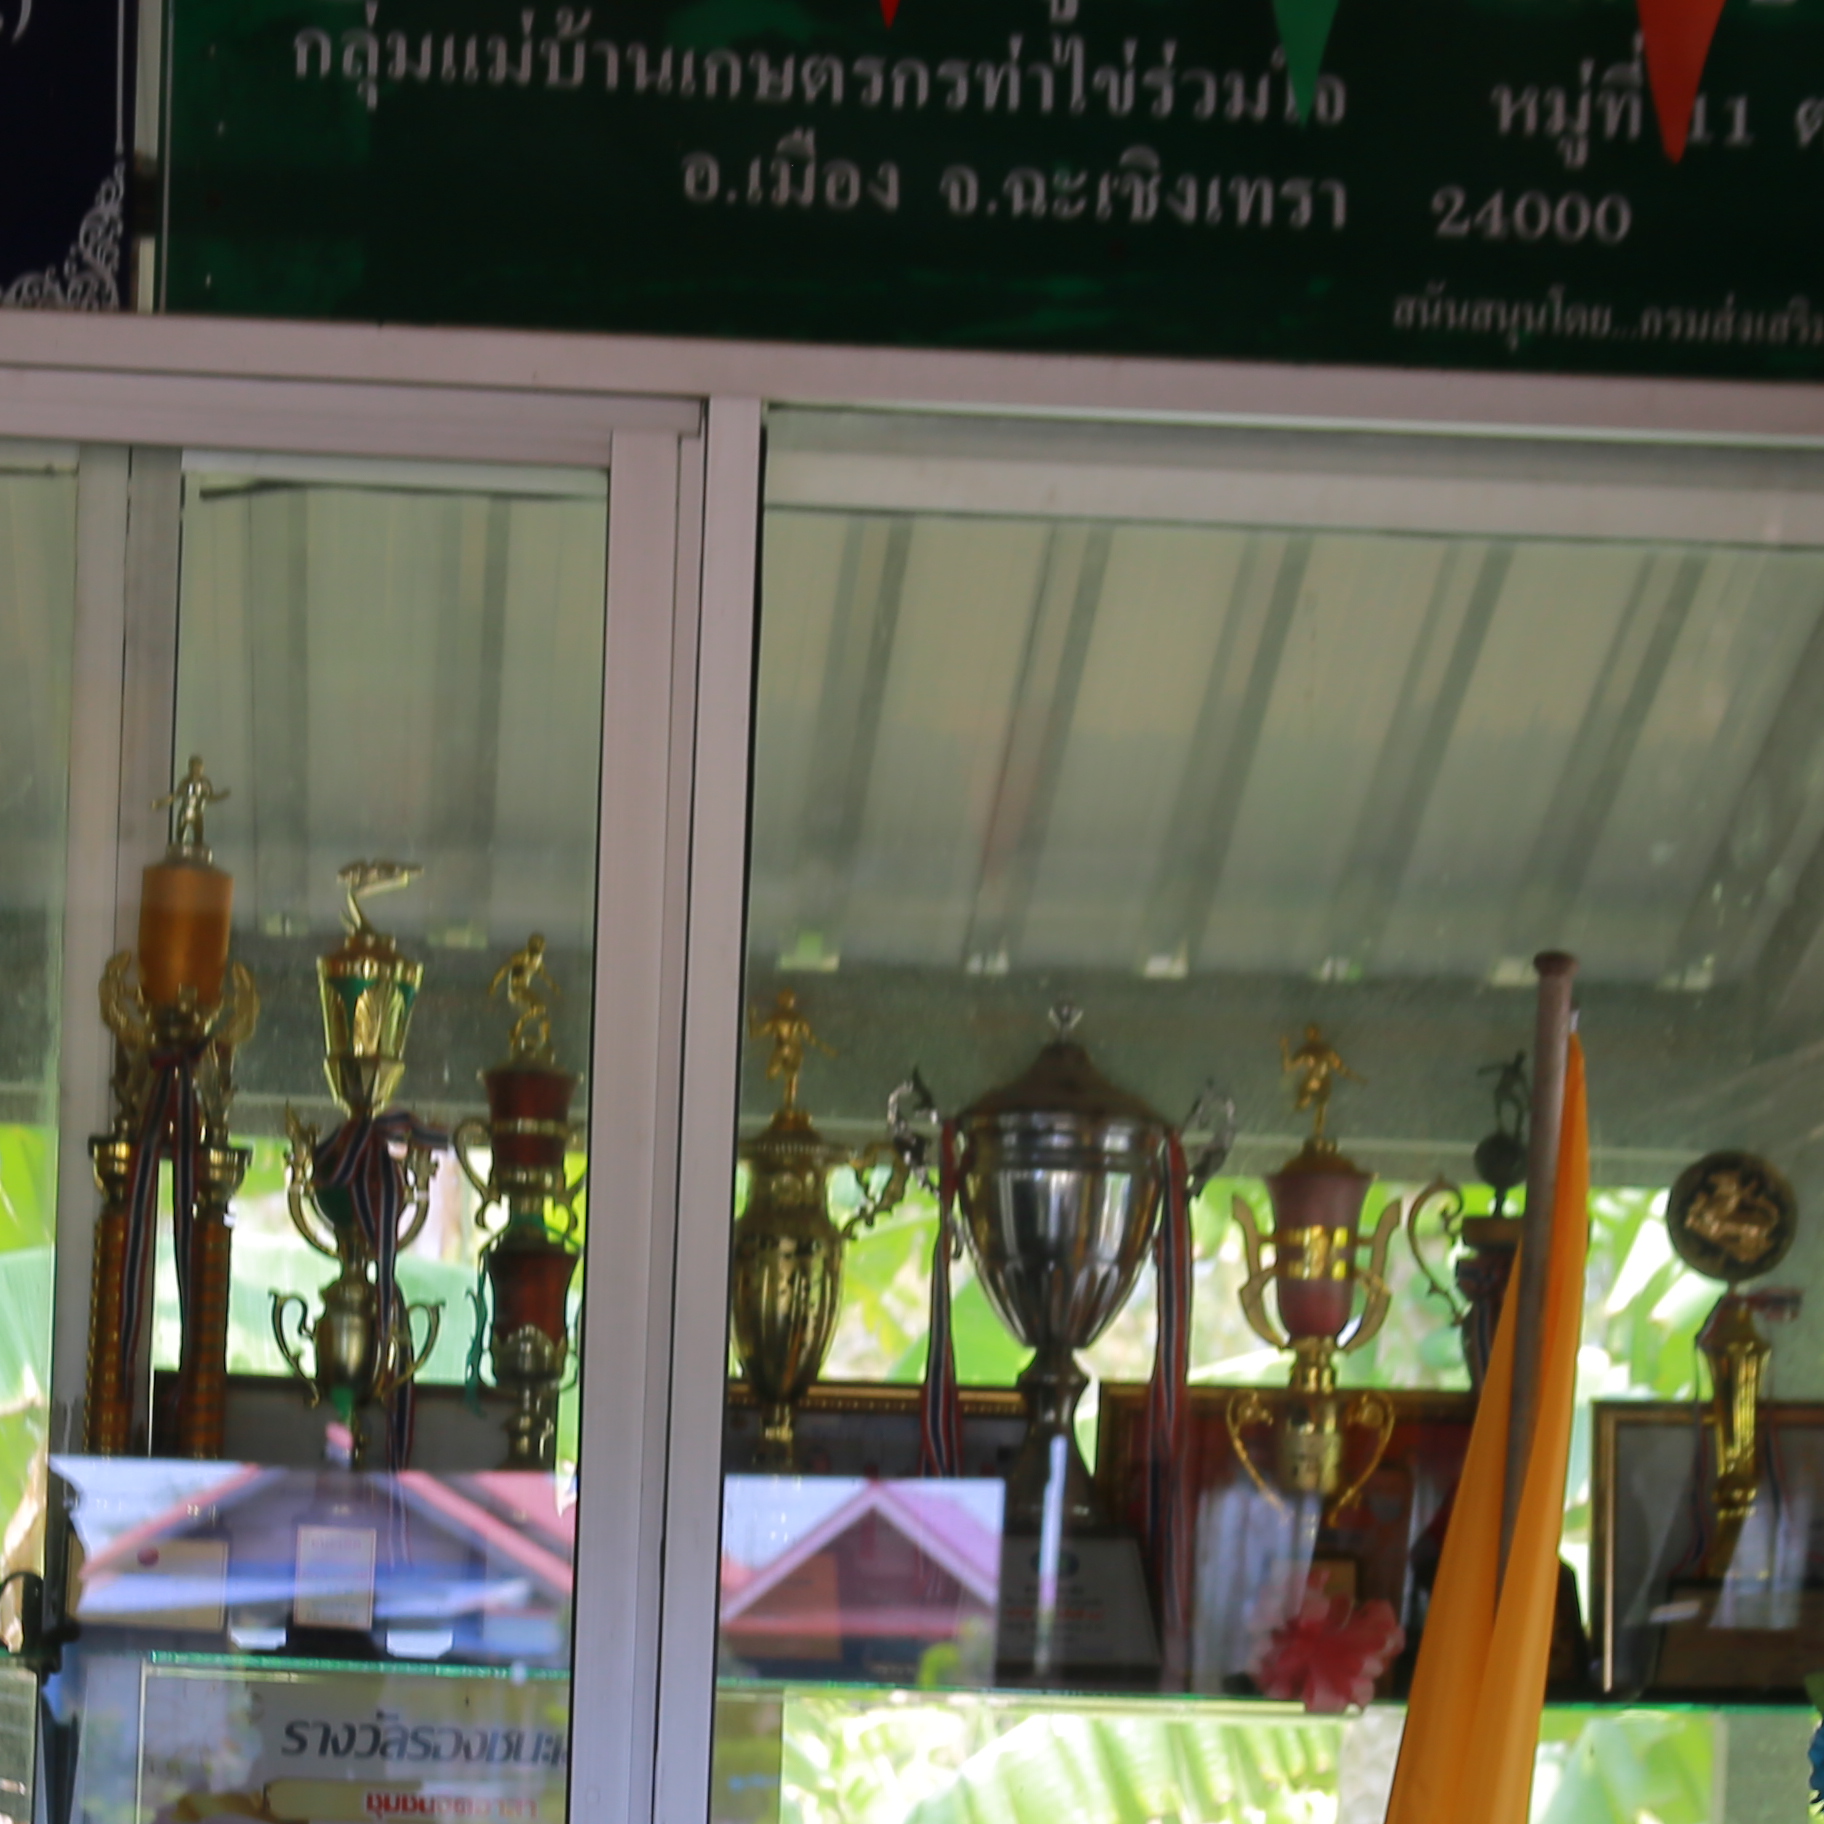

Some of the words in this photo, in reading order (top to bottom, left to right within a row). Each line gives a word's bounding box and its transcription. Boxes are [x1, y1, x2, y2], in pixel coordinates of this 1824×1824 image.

[1490, 28, 1644, 169] หมู่ที่
[1689, 93, 1753, 146] 11
[683, 127, 901, 211] อ.เมือง
[939, 145, 1348, 229] จ.ฉะเชิงเทรา
[1431, 188, 1632, 241] 24000
